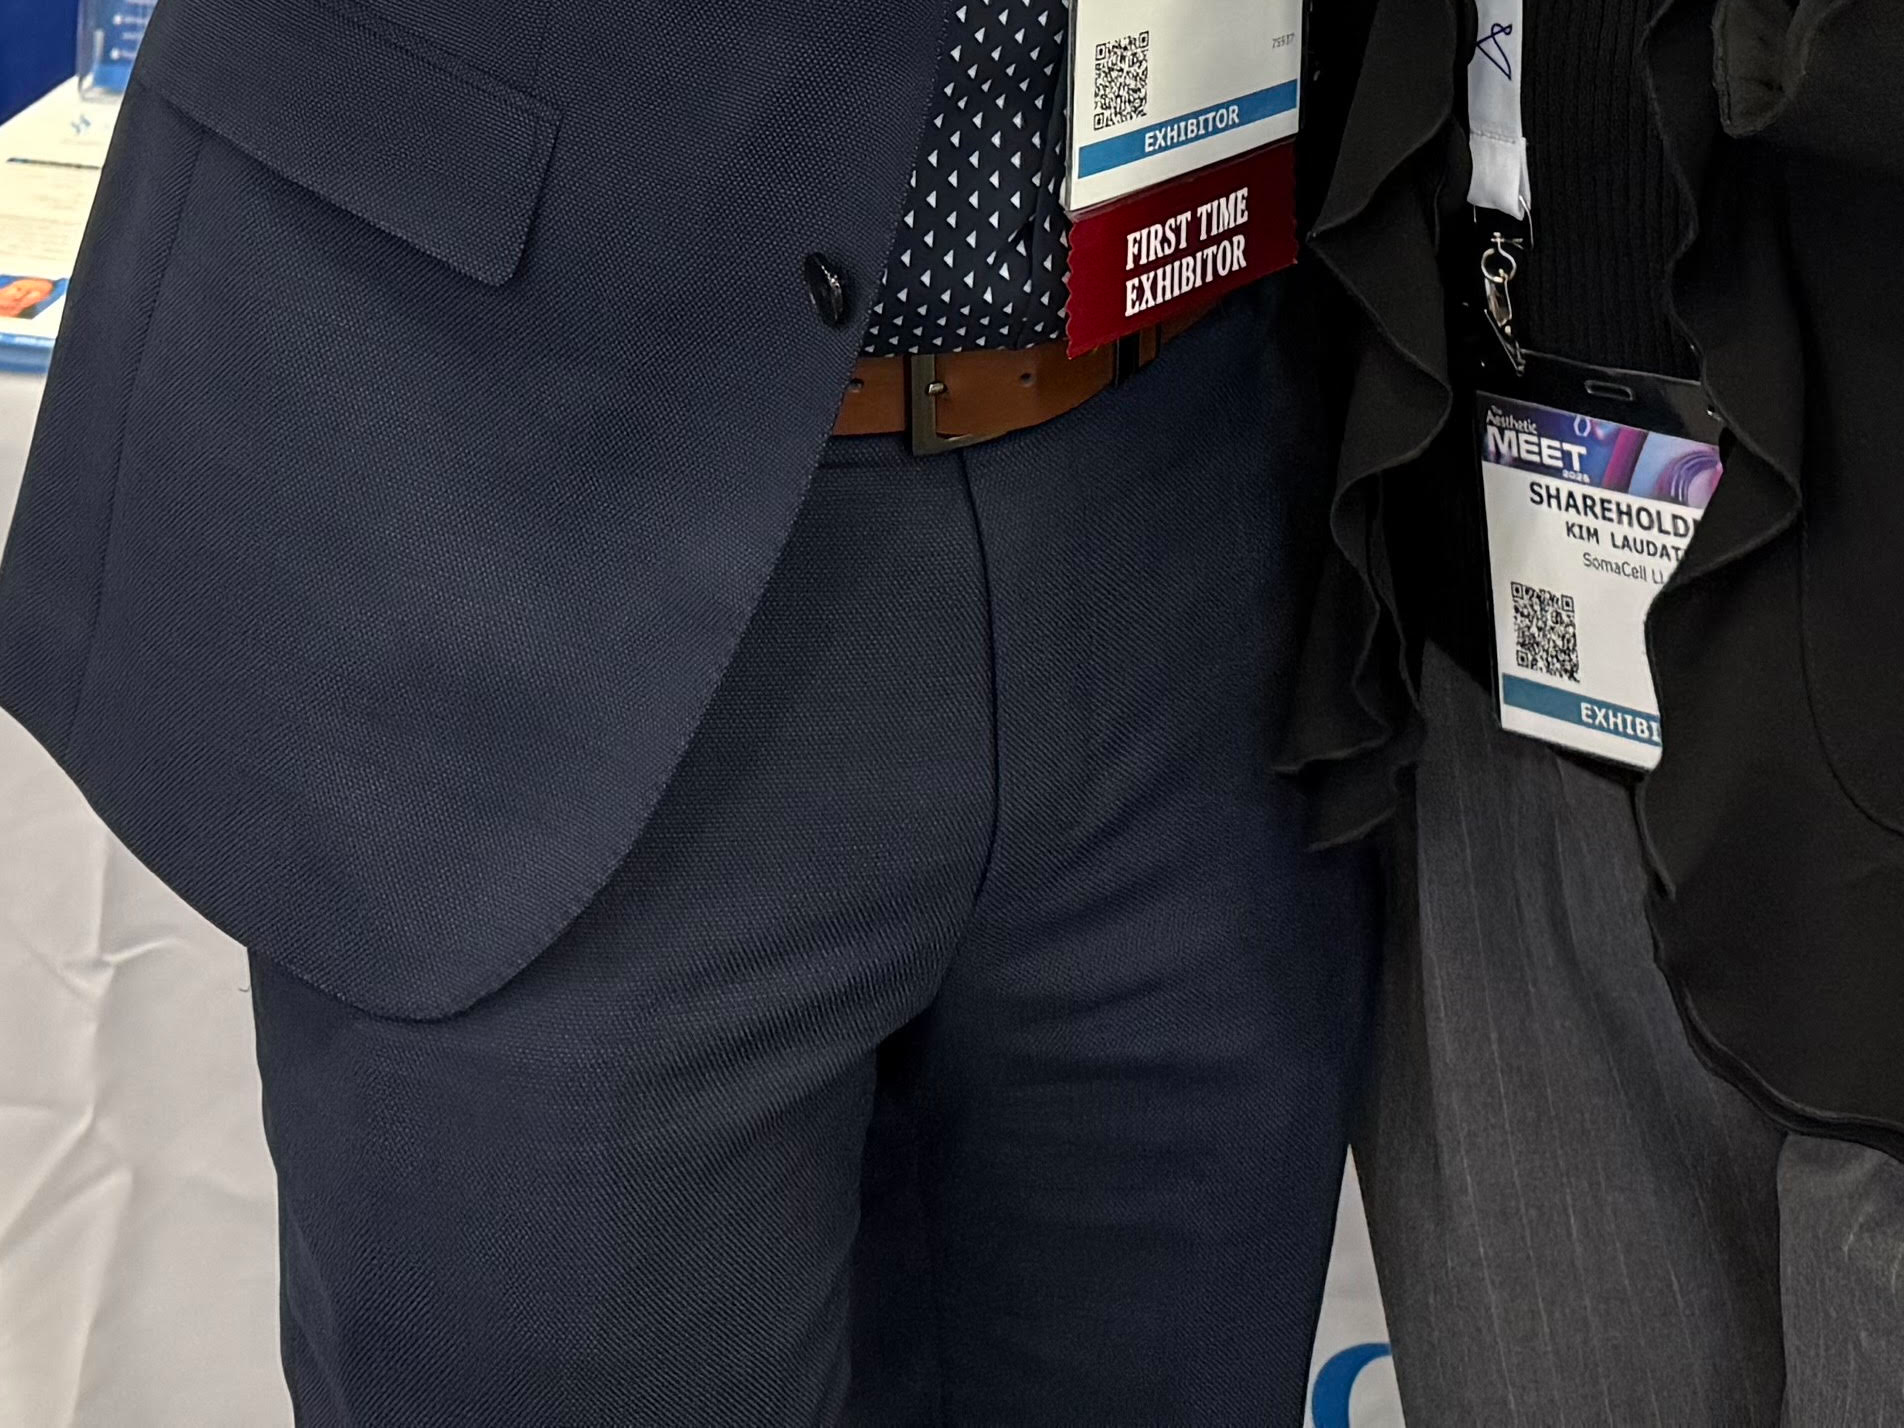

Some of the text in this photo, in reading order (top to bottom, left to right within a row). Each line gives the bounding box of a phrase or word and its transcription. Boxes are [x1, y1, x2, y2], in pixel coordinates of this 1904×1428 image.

[1144, 104, 1241, 154] EXHIBITOR
[1125, 186, 1250, 271] FIRST TIME
[1123, 234, 1248, 317] EXHIBITOR
[1486, 424, 1587, 472] MEET
[1565, 520, 1684, 562] KIM LAUDAT
[1582, 551, 1666, 585] SomaCell LL
[1580, 701, 1661, 743] EXHIBI
